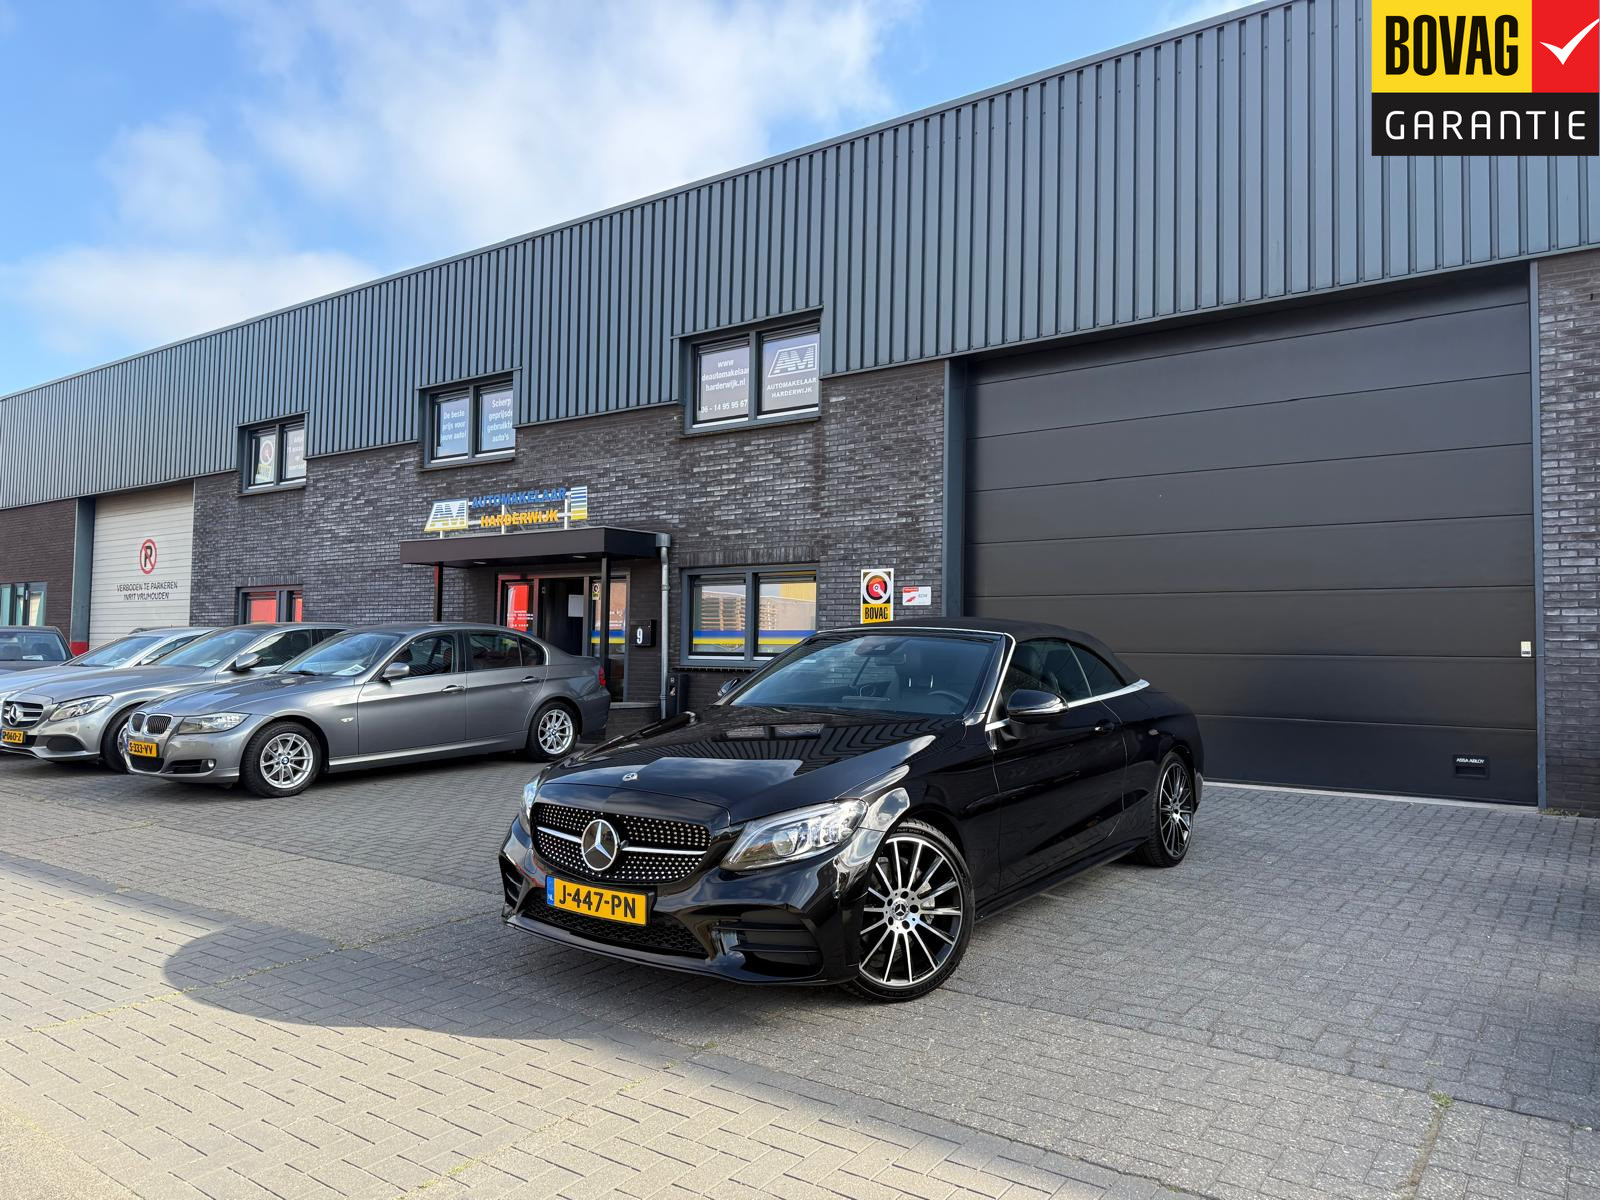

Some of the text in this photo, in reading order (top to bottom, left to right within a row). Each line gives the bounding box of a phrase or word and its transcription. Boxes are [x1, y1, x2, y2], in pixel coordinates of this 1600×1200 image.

[705, 378, 746, 392] harderwijk.nl
[766, 377, 817, 391] AUTOMAKELAAR
[771, 387, 813, 398] HARDERWIJK
[492, 399, 511, 408] Scherp
[471, 487, 567, 509] AUTOMAKELAAR
[480, 509, 559, 527] HARDERWIJK
[117, 581, 178, 592] VERBODEN TE PARKEREN
[123, 591, 170, 600] INRIT VRIJHOUDEN
[864, 606, 889, 620] BOVAG
[636, 627, 644, 645] 9
[558, 884, 636, 919] J-447-PN
